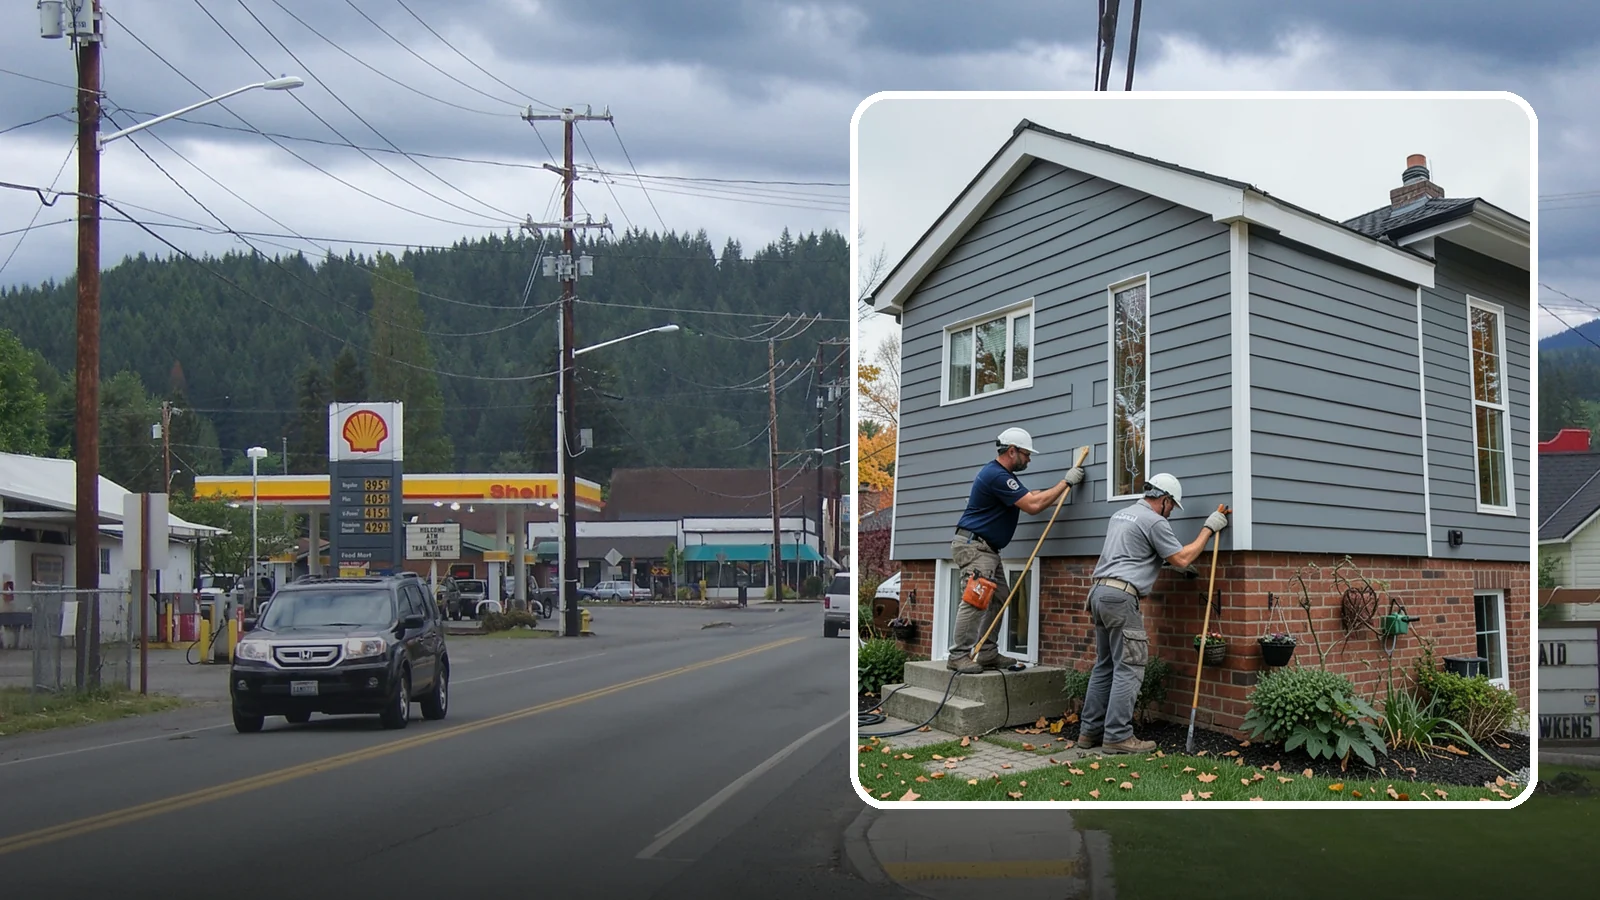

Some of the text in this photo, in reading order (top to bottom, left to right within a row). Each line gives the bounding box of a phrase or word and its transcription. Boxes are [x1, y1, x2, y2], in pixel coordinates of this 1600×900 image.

[365, 480, 383, 490] 395
[490, 484, 547, 499] Shell
[365, 494, 383, 504] 405
[365, 508, 383, 518] 415
[365, 522, 383, 533] 429
